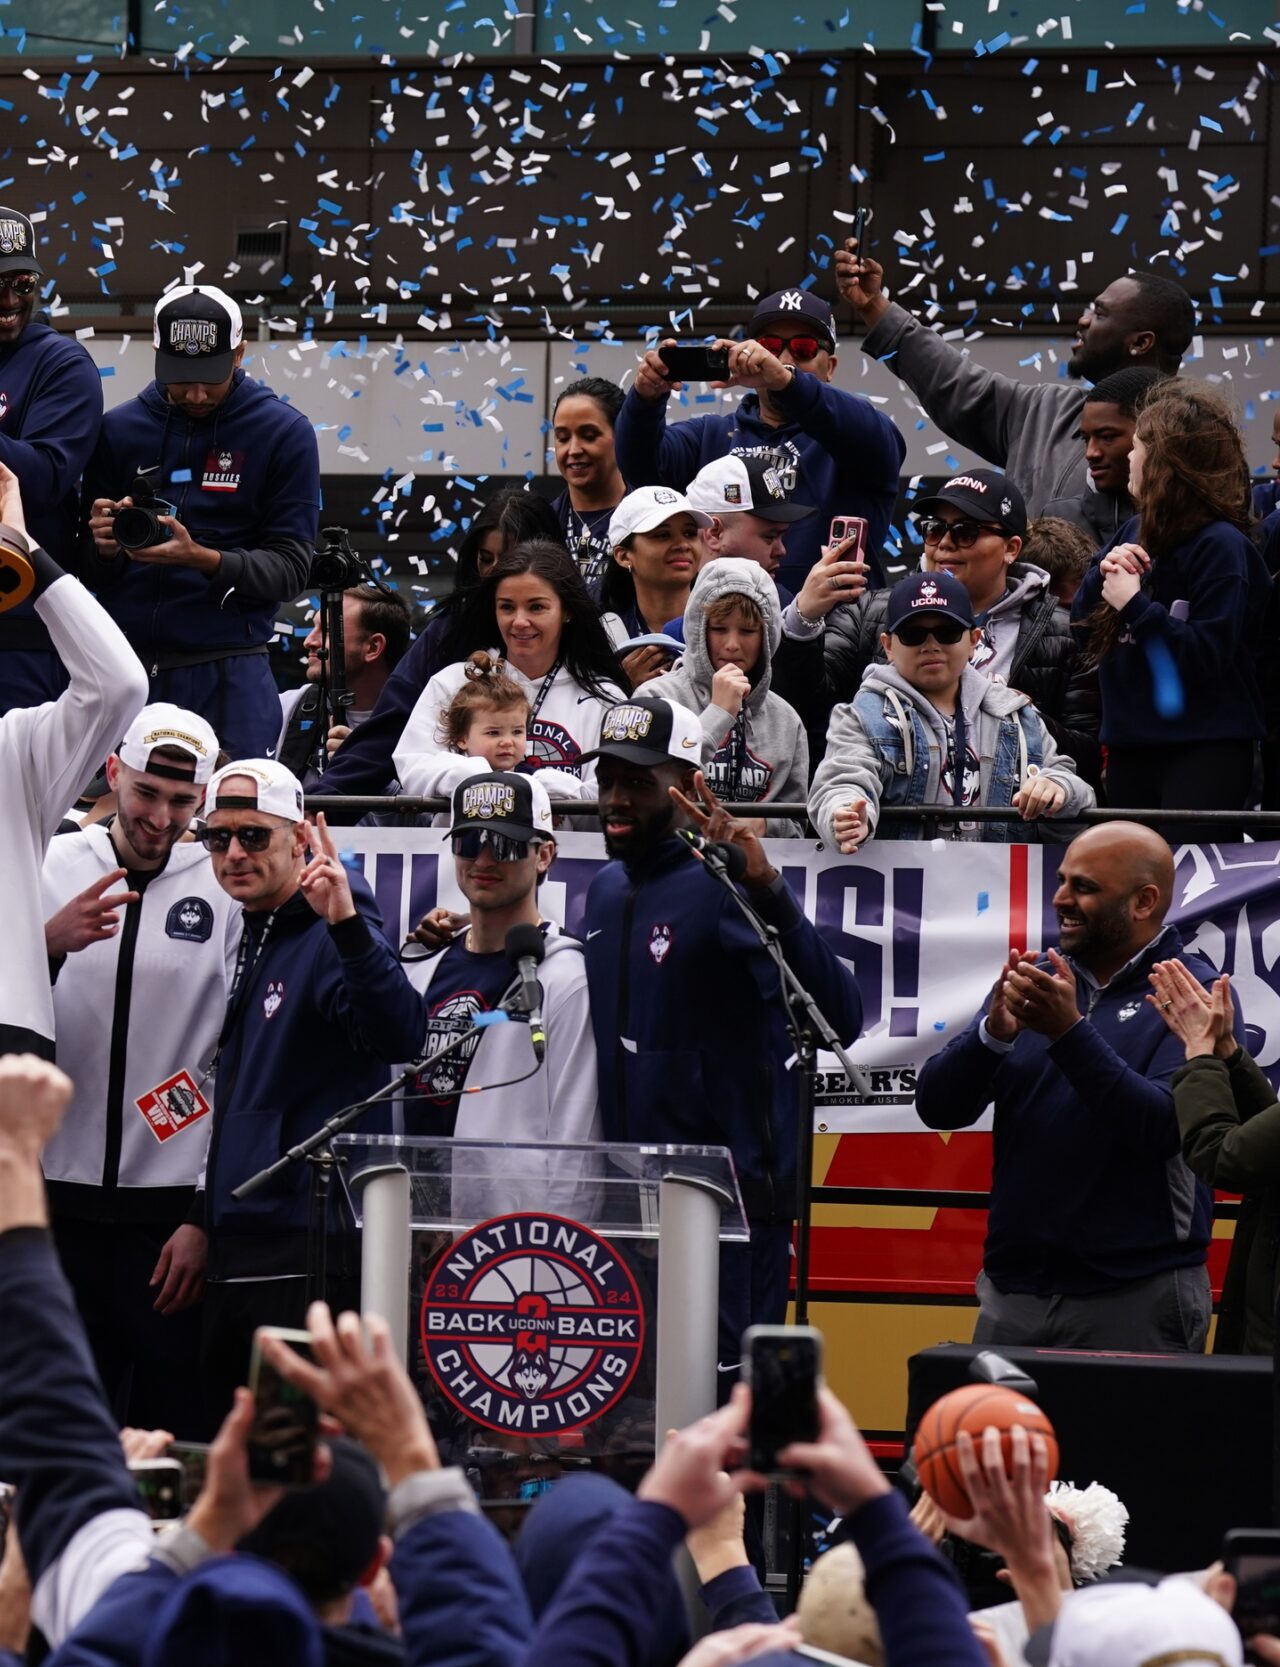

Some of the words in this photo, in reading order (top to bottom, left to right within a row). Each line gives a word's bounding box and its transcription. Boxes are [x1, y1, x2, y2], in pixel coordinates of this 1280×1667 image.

[779, 292, 803, 310] NY
[170, 321, 218, 347] CHAMPS
[203, 472, 240, 482] HUSKIES
[911, 598, 947, 607] UCONN
[603, 708, 652, 737] CHAMPS
[463, 785, 514, 813] CHAMPS
[147, 1104, 167, 1126] VIP
[447, 1221, 614, 1286] NATIONAL
[435, 1284, 458, 1298] 23
[607, 1291, 631, 1304] 24
[428, 1312, 505, 1333] BACK
[508, 1318, 555, 1331] UCONN
[558, 1317, 635, 1338] BACK
[437, 1349, 628, 1429] CHAMPIONS
